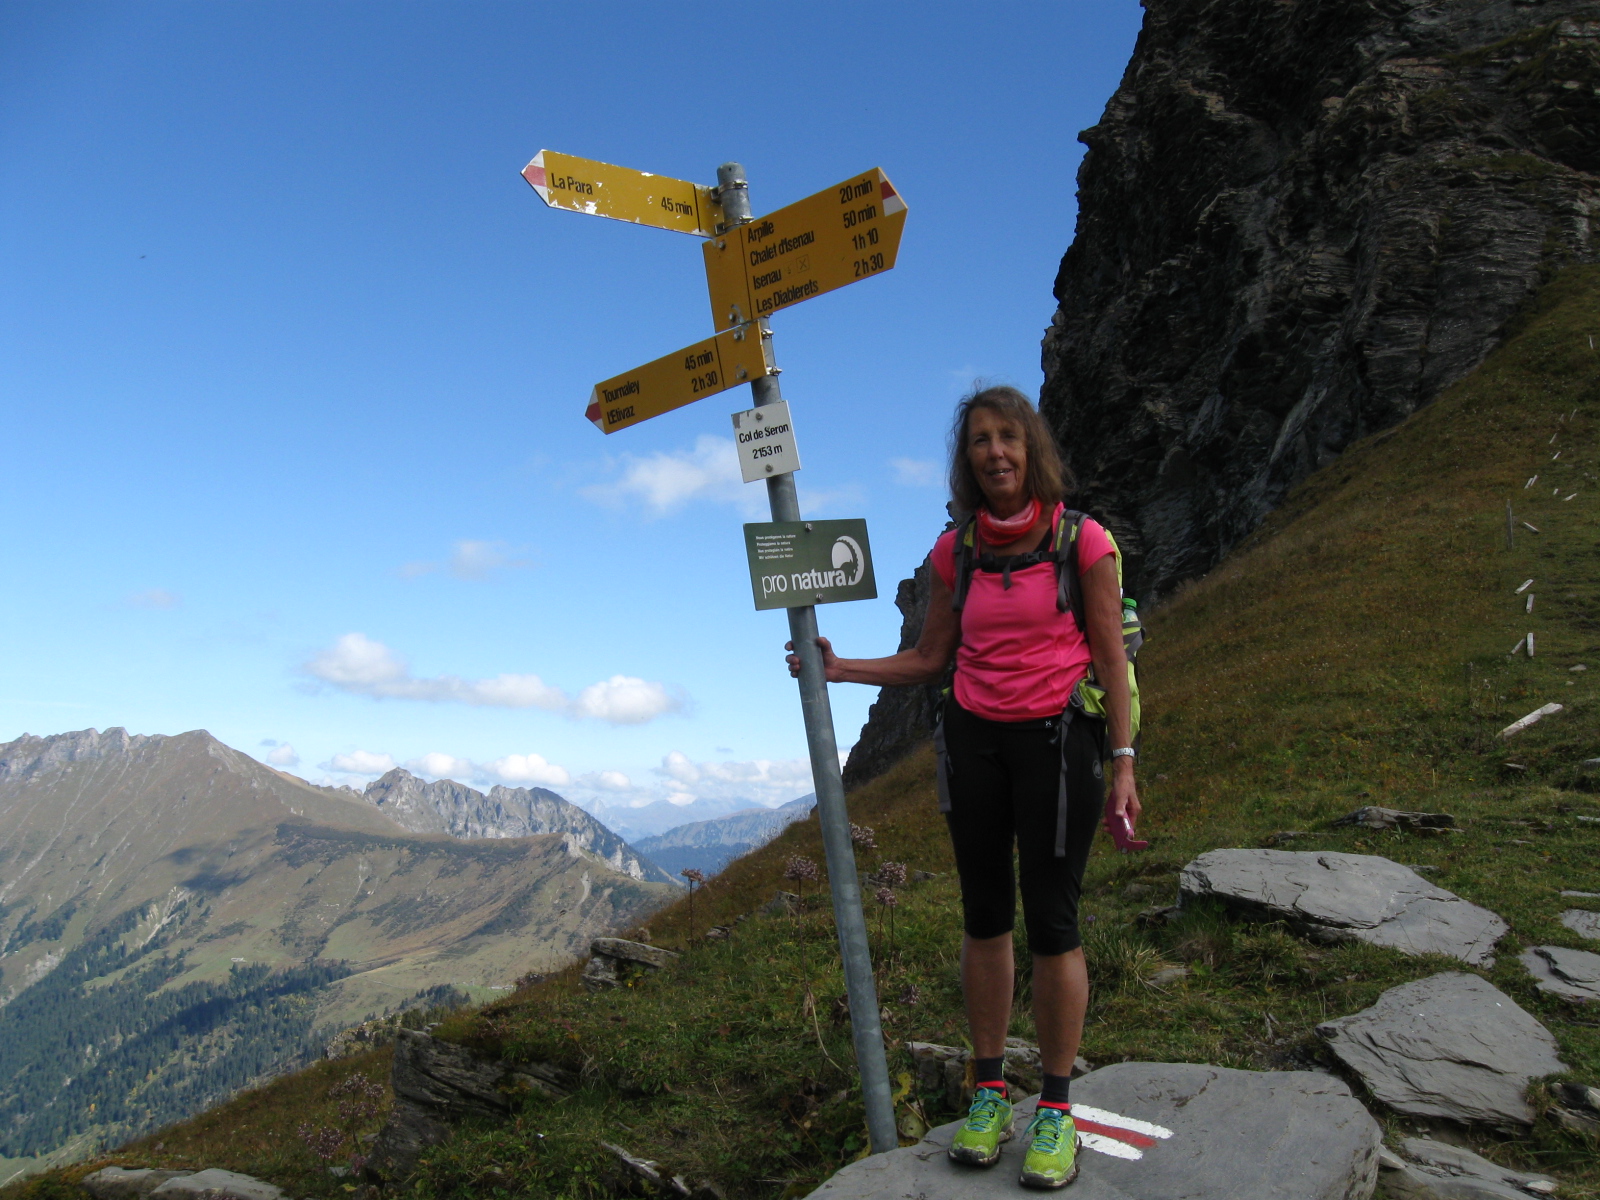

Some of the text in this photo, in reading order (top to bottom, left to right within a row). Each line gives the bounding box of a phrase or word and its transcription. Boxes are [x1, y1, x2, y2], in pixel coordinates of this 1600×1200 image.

[551, 173, 593, 195] La Para
[840, 179, 873, 204] 20 min
[661, 197, 693, 216] 45 min
[843, 204, 877, 229] 50 min
[748, 220, 775, 243] Arpille
[867, 228, 879, 246] 10
[750, 247, 777, 266] Chalet
[870, 252, 884, 271] 30
[753, 269, 782, 290] Isenau
[756, 279, 819, 314] Les Diablerets
[685, 350, 714, 371] 45 min
[705, 371, 718, 388] 30
[602, 380, 640, 403] Tournaley
[739, 422, 789, 444] Col de Seron
[752, 444, 783, 459] 2153 m
[761, 568, 847, 599] pro natura
